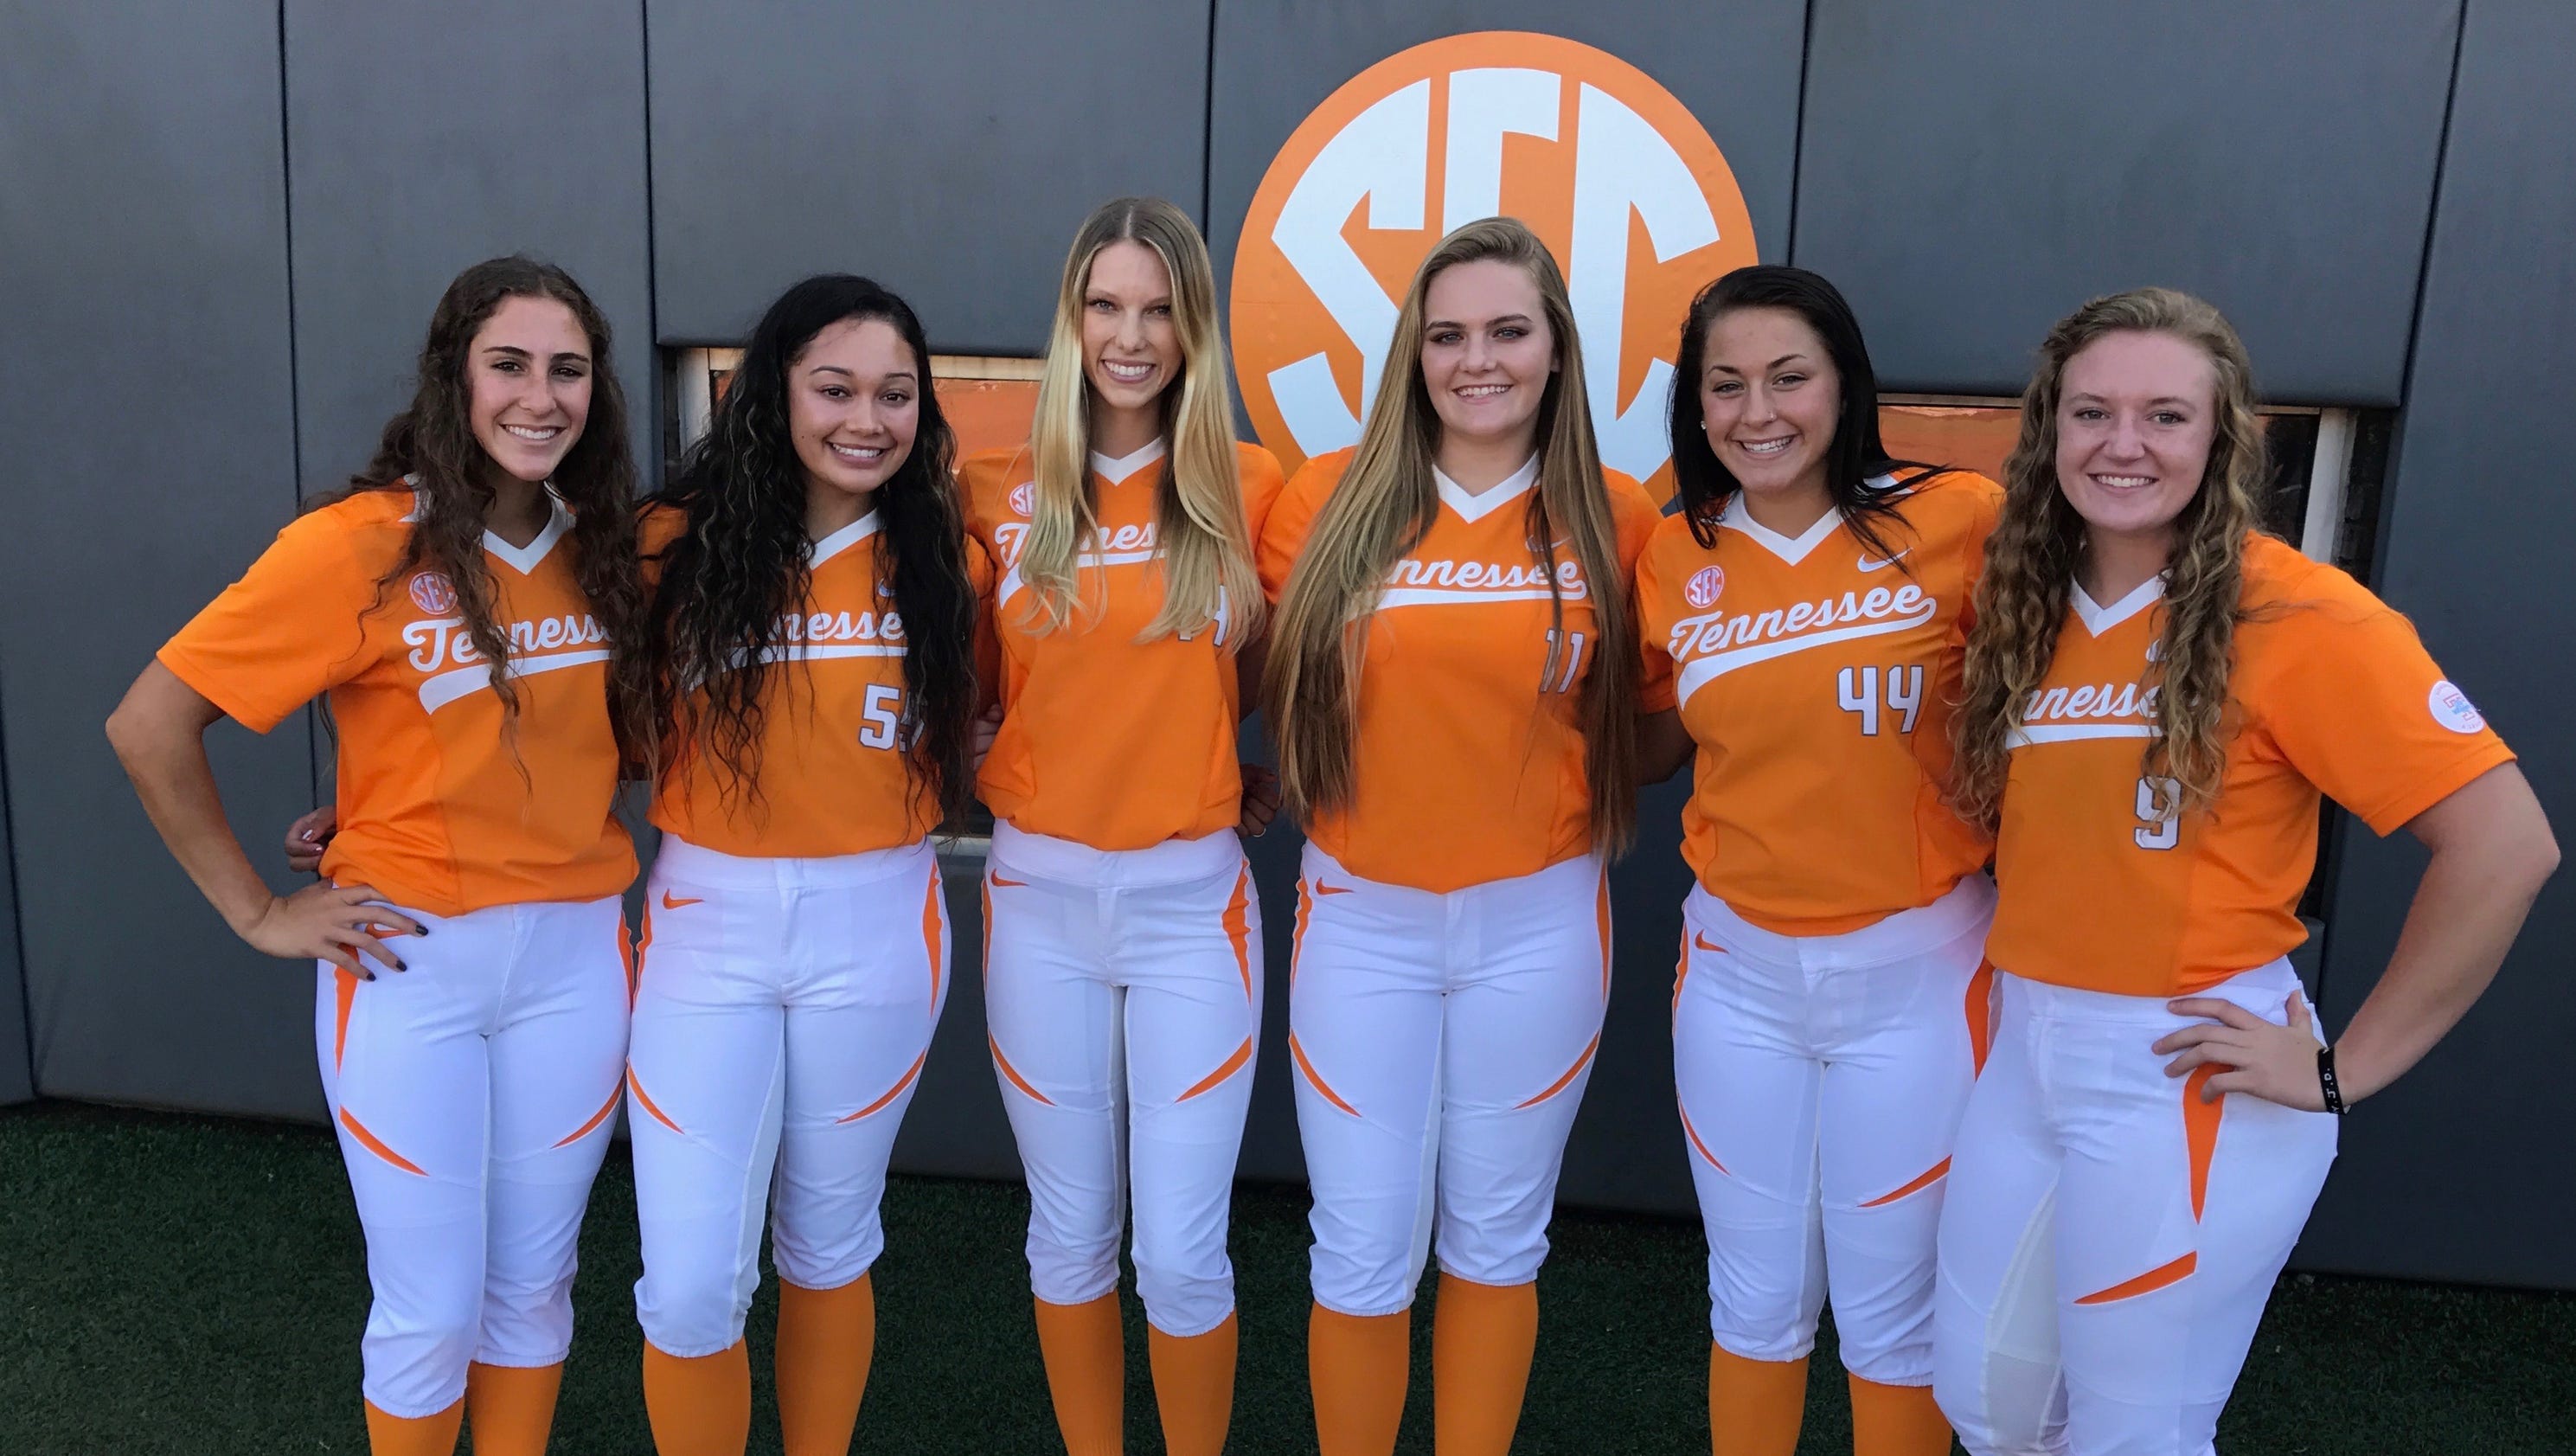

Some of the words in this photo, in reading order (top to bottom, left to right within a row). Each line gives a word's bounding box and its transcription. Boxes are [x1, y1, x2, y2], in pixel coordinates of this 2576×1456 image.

[1689, 568, 1721, 605] SEC
[1538, 627, 1585, 693] 11
[1668, 585, 1937, 664] Tennessee
[1836, 664, 1916, 736] 44
[2134, 776, 2182, 850] 9
